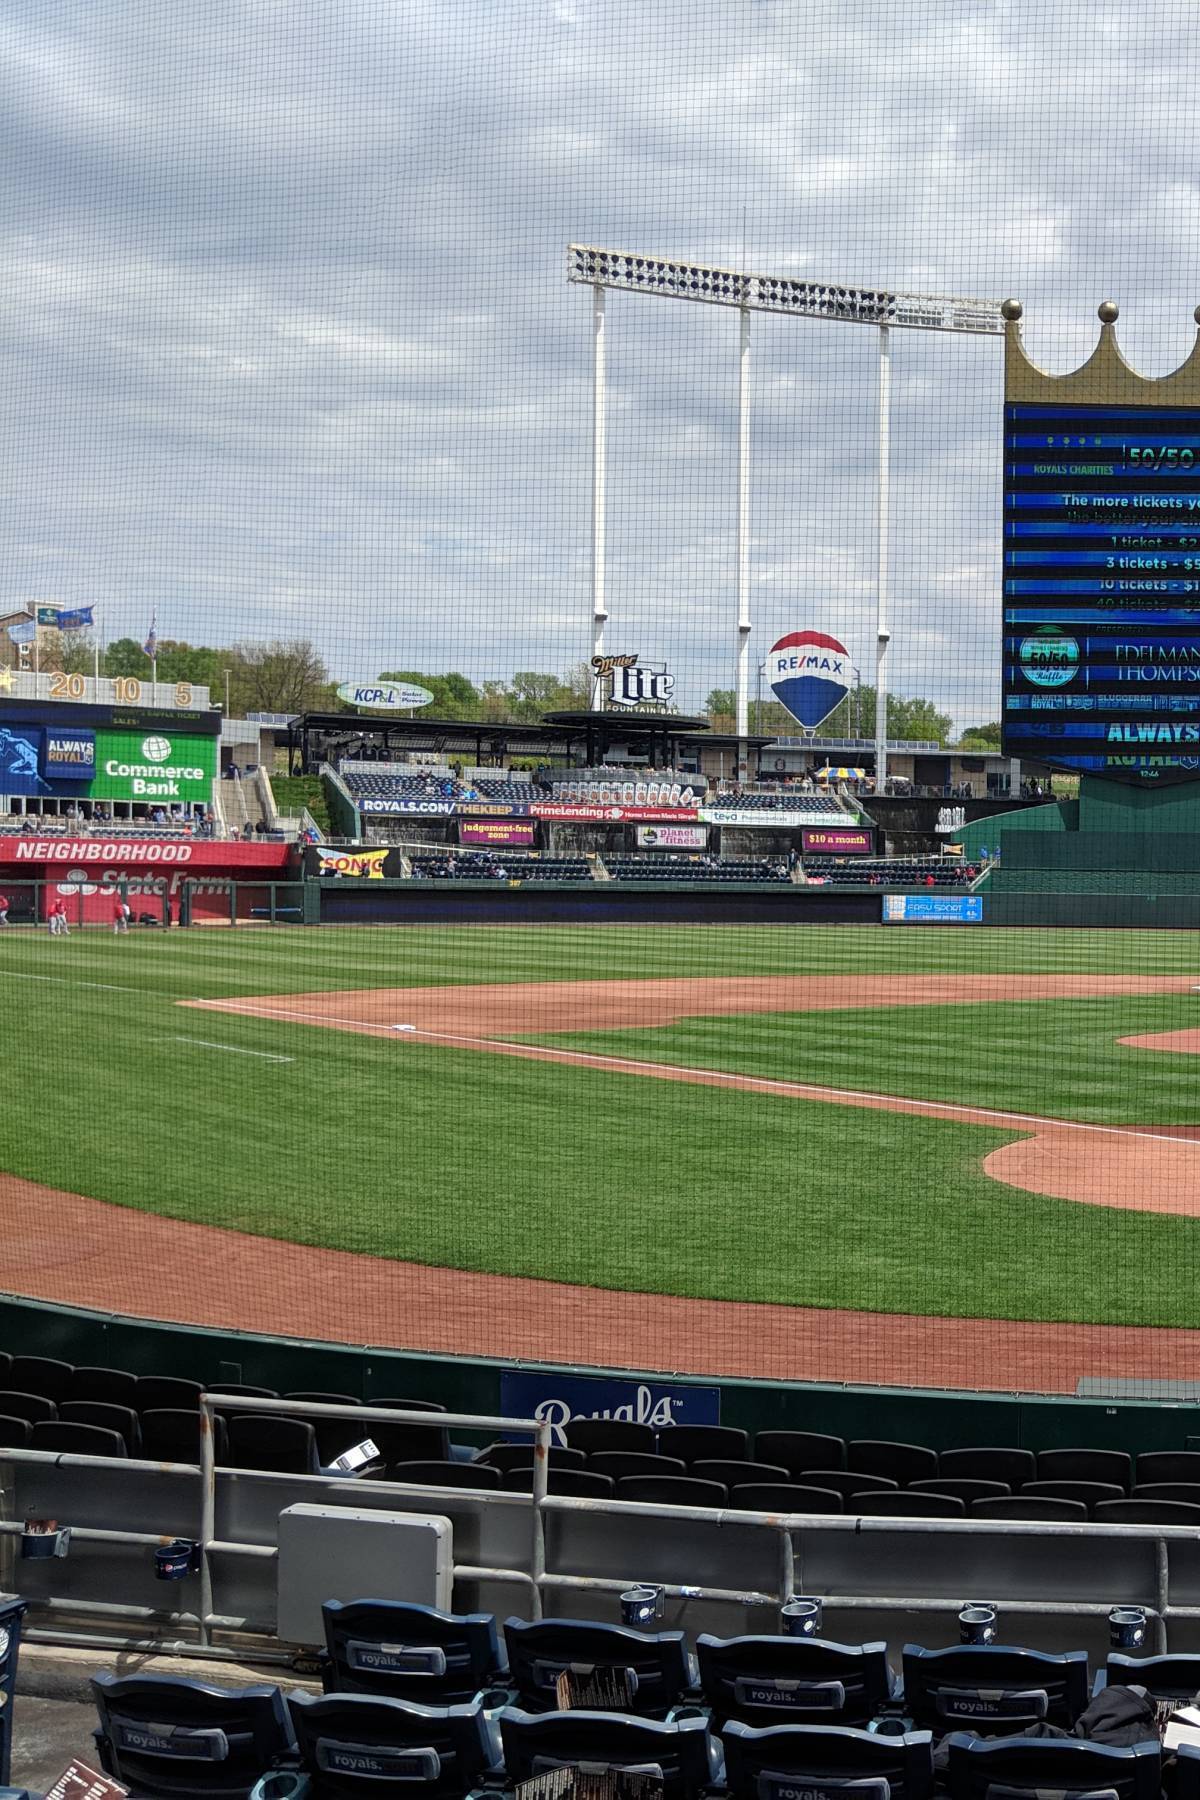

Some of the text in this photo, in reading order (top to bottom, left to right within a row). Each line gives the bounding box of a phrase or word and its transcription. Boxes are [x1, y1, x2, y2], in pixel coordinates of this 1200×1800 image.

[1034, 465, 1114, 475] ROYALS CHARITIES
[1062, 494, 1088, 506] The
[1093, 499, 1129, 507] more
[1133, 496, 1183, 508] tickets
[1122, 536, 1163, 548] ticket
[1106, 557, 1115, 568] 3
[1119, 557, 1168, 569] tickets
[1119, 580, 1168, 591] tickets
[592, 653, 639, 677] Miller
[777, 655, 843, 675] RE/MAX
[50, 671, 193, 706] 20 10 5
[608, 666, 675, 706] Lite
[354, 688, 396, 704] KCP&L
[606, 705, 656, 714] FOUNTAIN
[1107, 723, 1199, 742] ALWAYS
[49, 739, 94, 753] ALWAYS
[49, 751, 83, 763] ROYAL
[106, 760, 204, 780] Commerce
[133, 779, 180, 796] Bank
[530, 805, 604, 819] PrimeLending
[464, 824, 533, 833] judgement-free
[487, 831, 510, 839] zone
[659, 827, 694, 838] planet
[665, 835, 701, 845] fitness
[808, 834, 826, 843] $10
[835, 835, 866, 844] month
[16, 842, 192, 861] NEIGHBORHOOD
[101, 870, 164, 895] State
